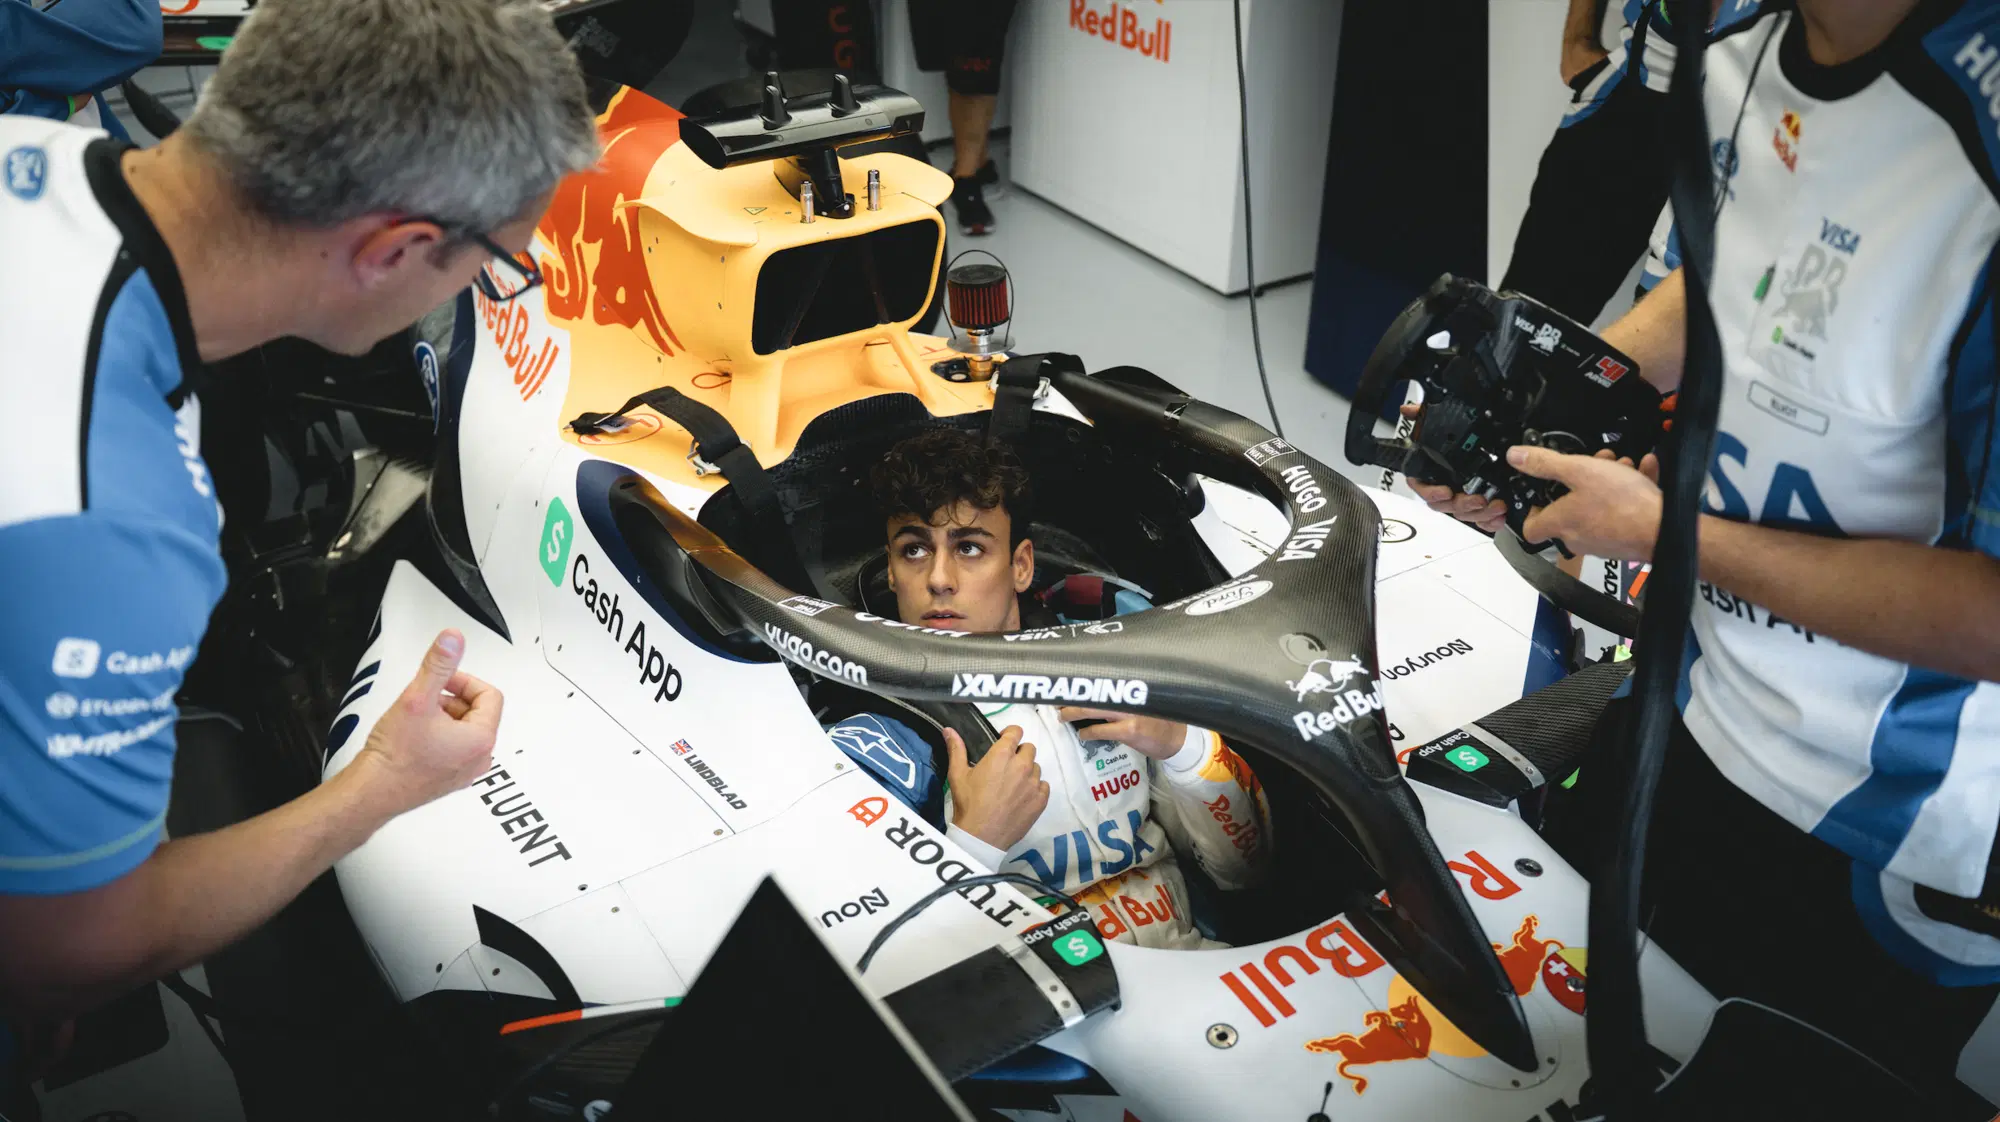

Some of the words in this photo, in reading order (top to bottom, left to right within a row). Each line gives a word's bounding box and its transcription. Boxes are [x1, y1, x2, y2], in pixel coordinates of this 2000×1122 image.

[1070, 0, 1117, 42] Red
[1120, 8, 1171, 63] Bull
[1819, 215, 1861, 257] VISA
[504, 304, 560, 402] Bull
[1280, 464, 1327, 513] HUGO
[1701, 430, 1849, 538] SA
[1276, 515, 1338, 562] VISA
[1202, 586, 1254, 608] Ford
[572, 553, 624, 643] Cash
[624, 620, 682, 703] App
[764, 622, 869, 687] yugo.com
[1381, 638, 1474, 680] Nouryon
[952, 673, 1149, 705] XMTRADING
[1293, 694, 1351, 742] Red
[1443, 731, 1471, 747] Cash
[1418, 740, 1443, 758] App
[684, 754, 748, 810] LINDBLAD
[1091, 769, 1140, 802] HUGO
[471, 763, 573, 868] FLUENT
[885, 816, 1024, 928] TUDOR
[1009, 809, 1156, 891] VISA
[818, 887, 890, 929] Nou
[1054, 910, 1092, 932] Cash
[1023, 925, 1055, 945] App
[1219, 919, 1387, 1029] Bull
